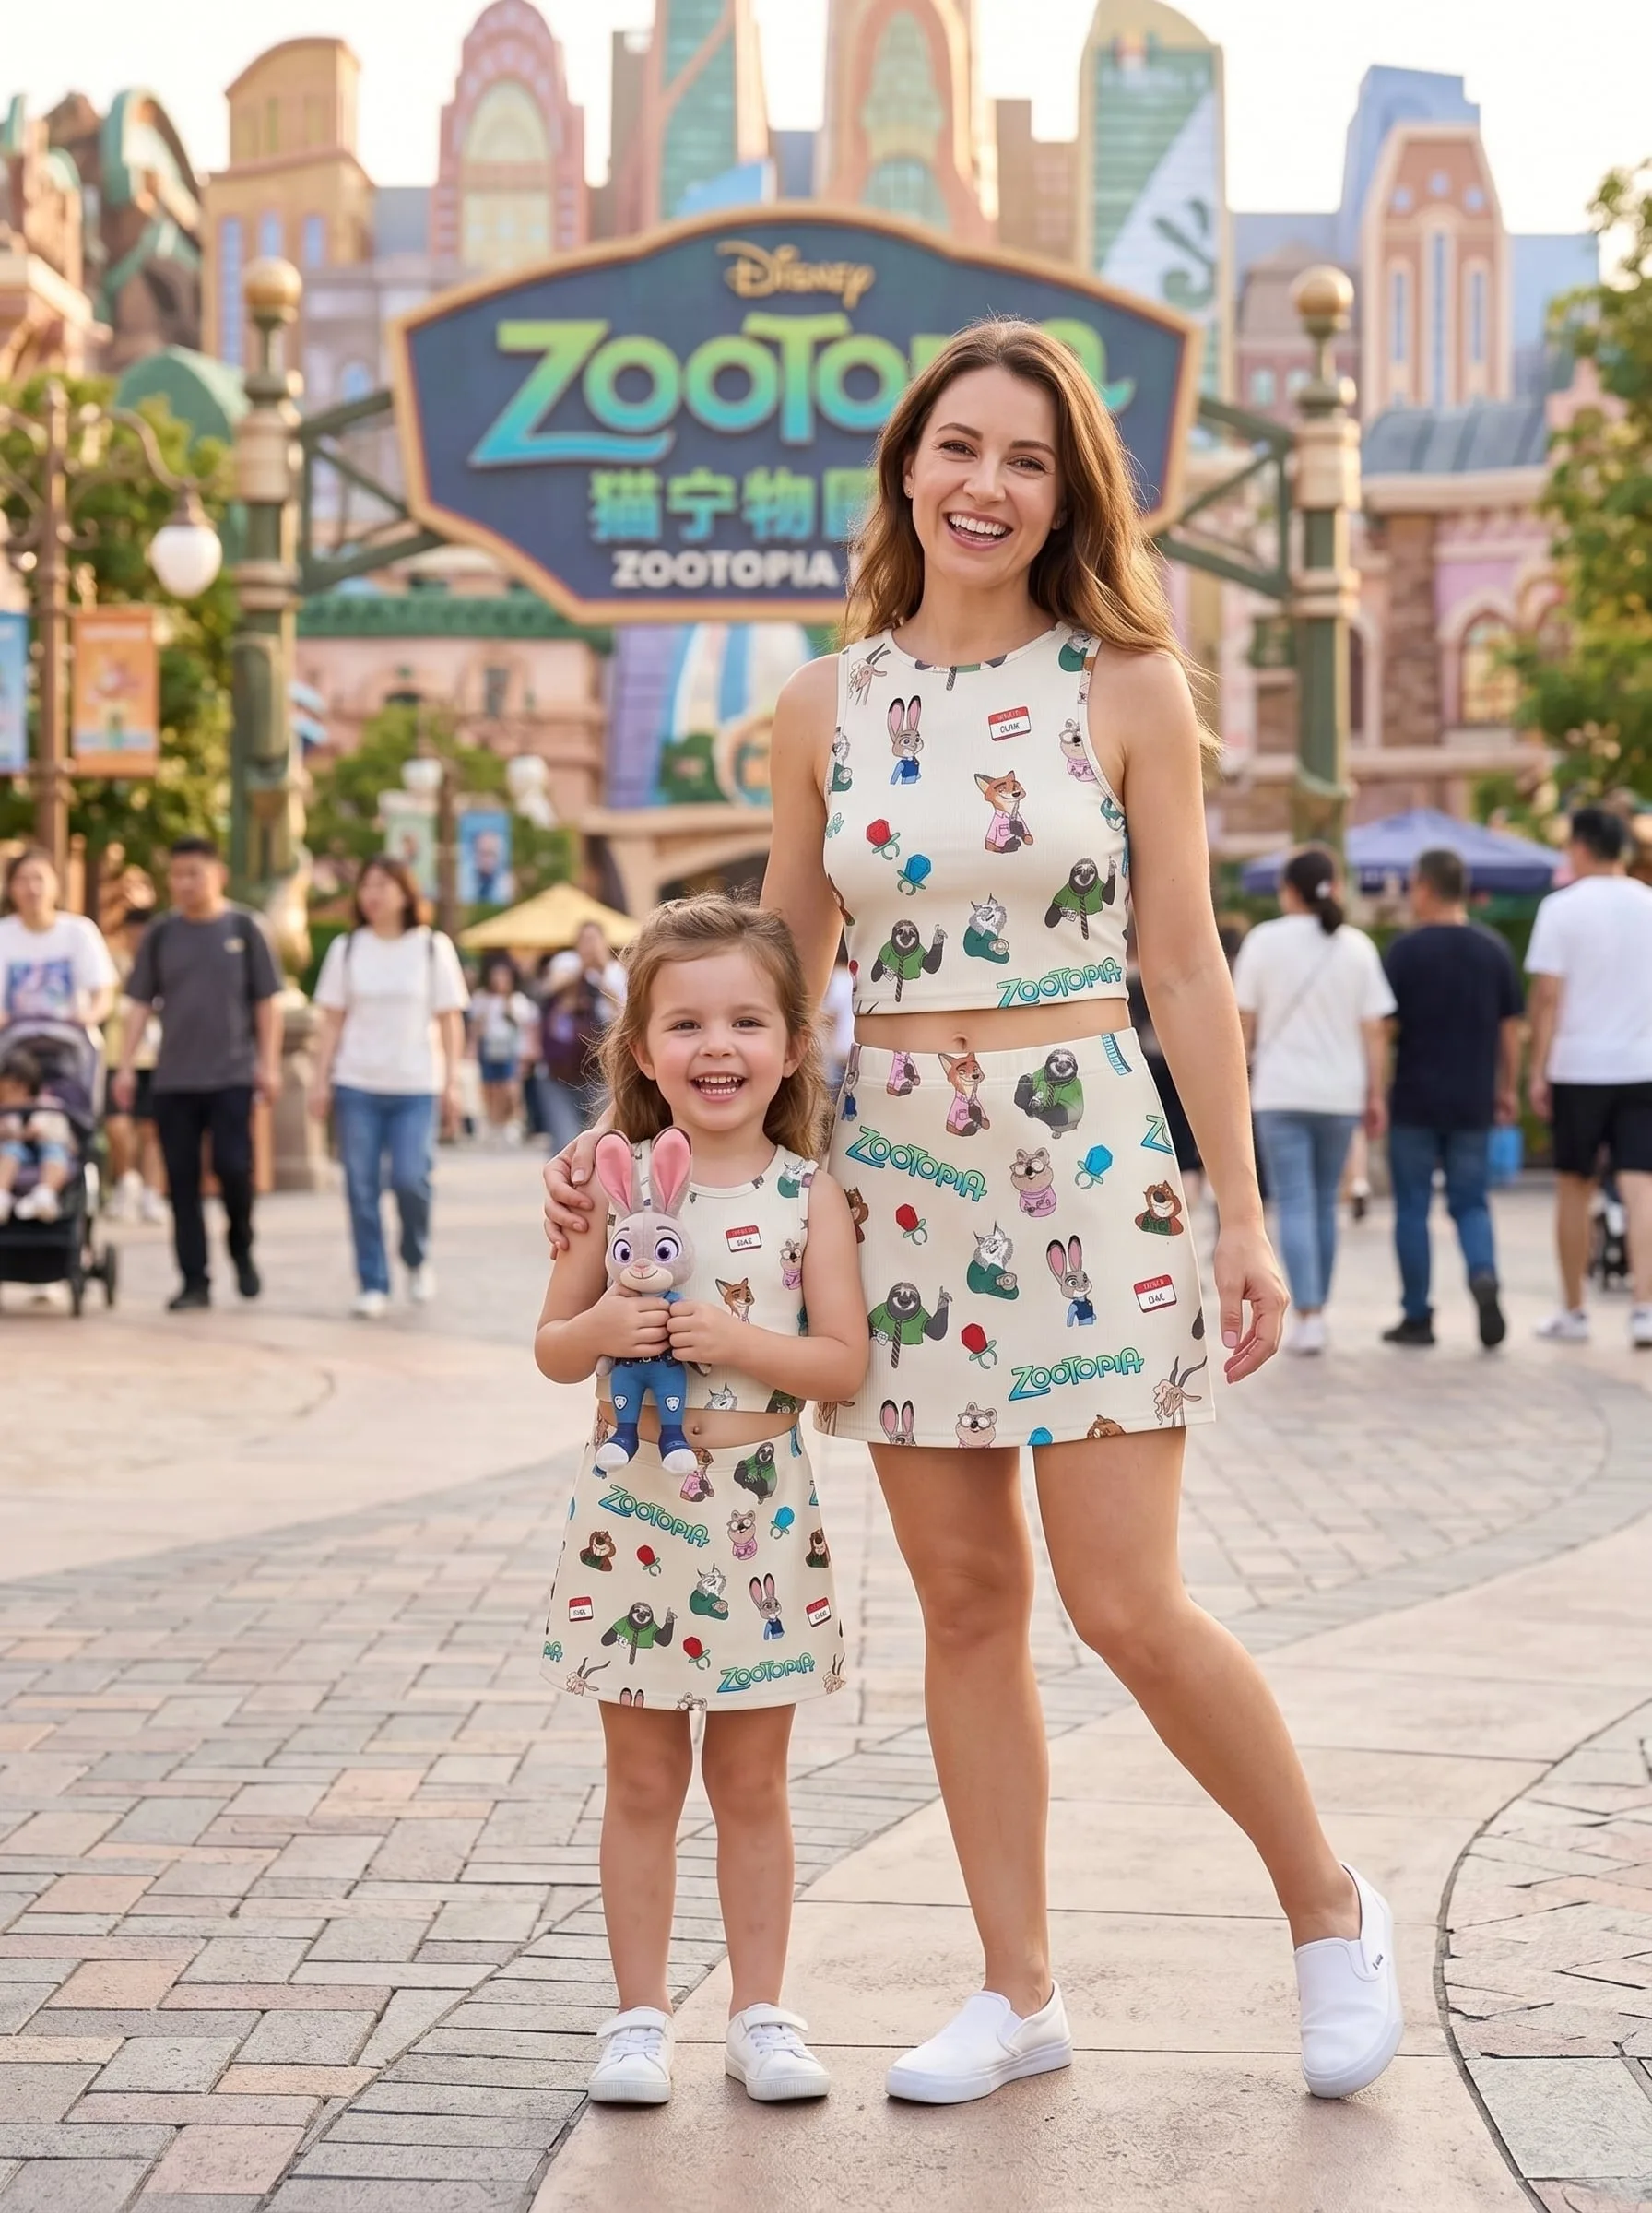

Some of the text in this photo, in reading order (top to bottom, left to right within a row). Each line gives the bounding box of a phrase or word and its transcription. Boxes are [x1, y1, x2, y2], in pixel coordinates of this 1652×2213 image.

[612, 550, 841, 587] ZOOTOPIA
[997, 957, 1122, 1009] ZOOTOPIA
[845, 1125, 987, 1202] ZOOTOPIA
[1008, 1347, 1145, 1402] ZOOTOPIA
[598, 1484, 711, 1548] ZOOTOPIA
[716, 1652, 815, 1694] ZOOTOPIA
